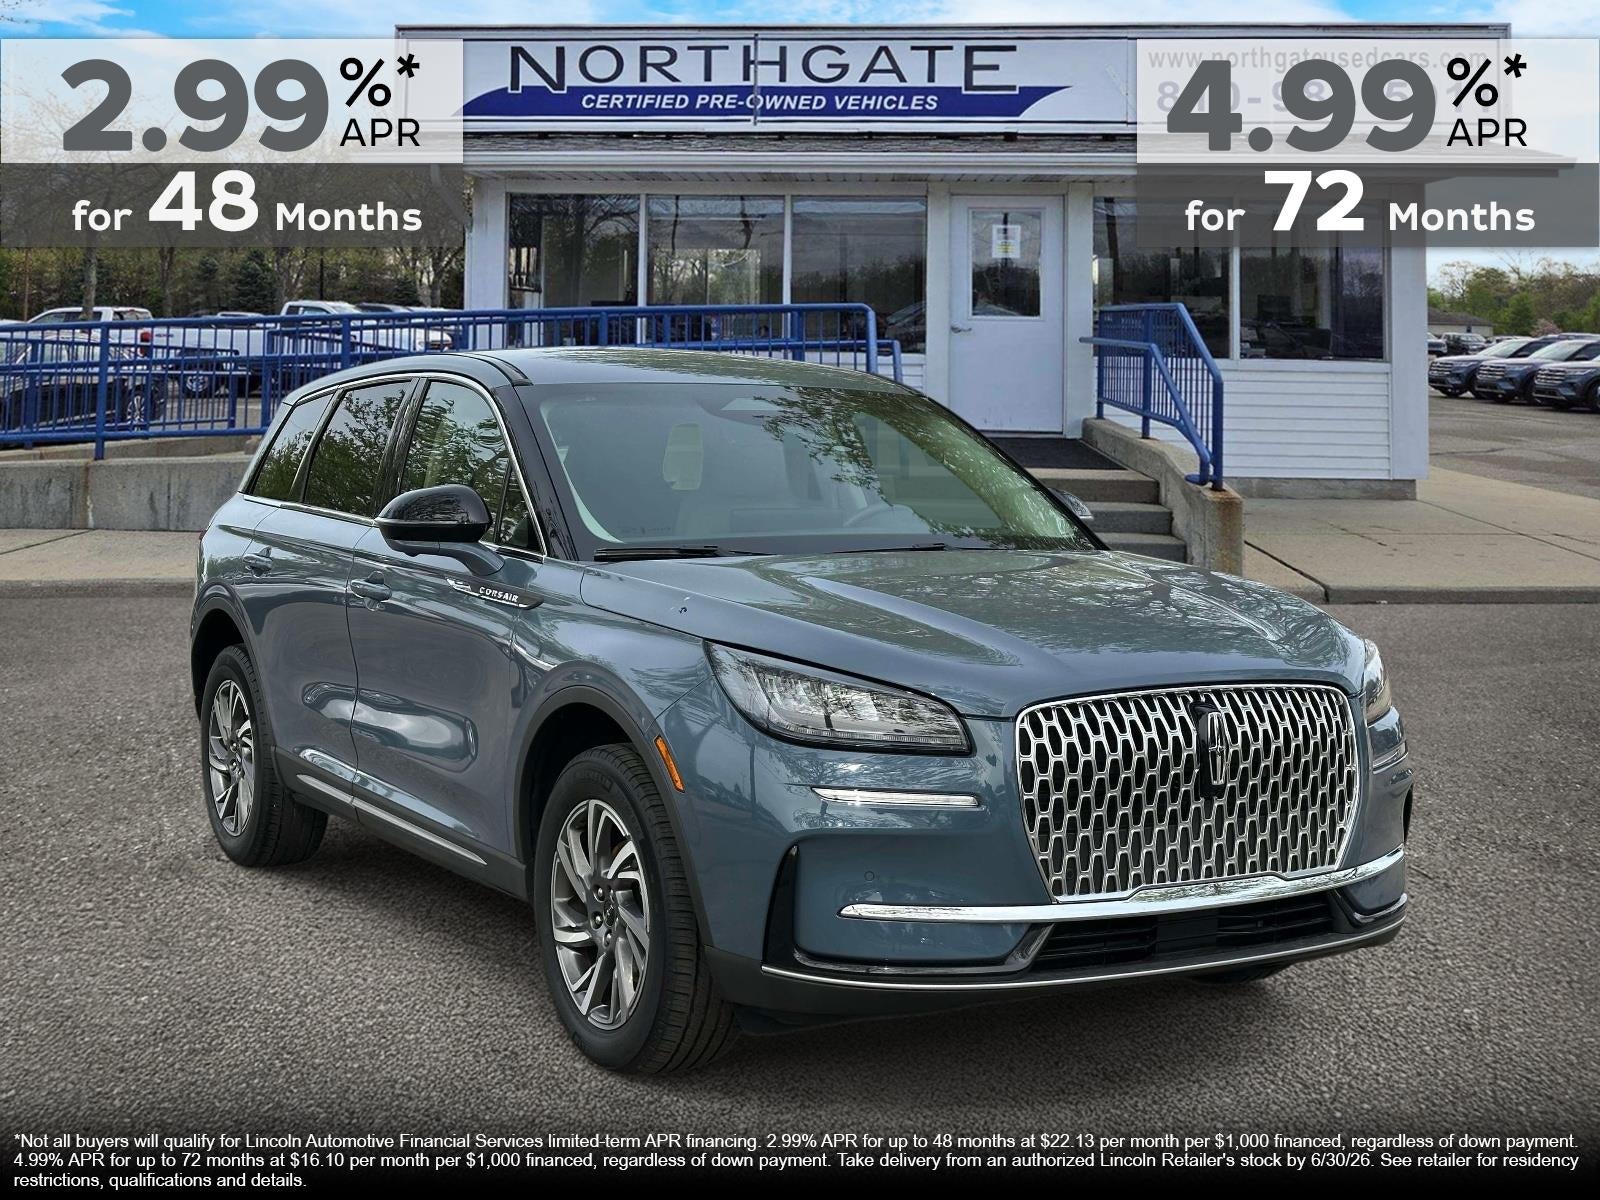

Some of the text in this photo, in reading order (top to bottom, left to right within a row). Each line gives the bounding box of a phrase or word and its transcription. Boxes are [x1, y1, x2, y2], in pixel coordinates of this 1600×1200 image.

[507, 44, 1018, 92] NORTHGATE
[581, 94, 939, 110] CERTIFIED PRE-OWNED VEHICLES
[479, 586, 519, 602] CORSAIR
